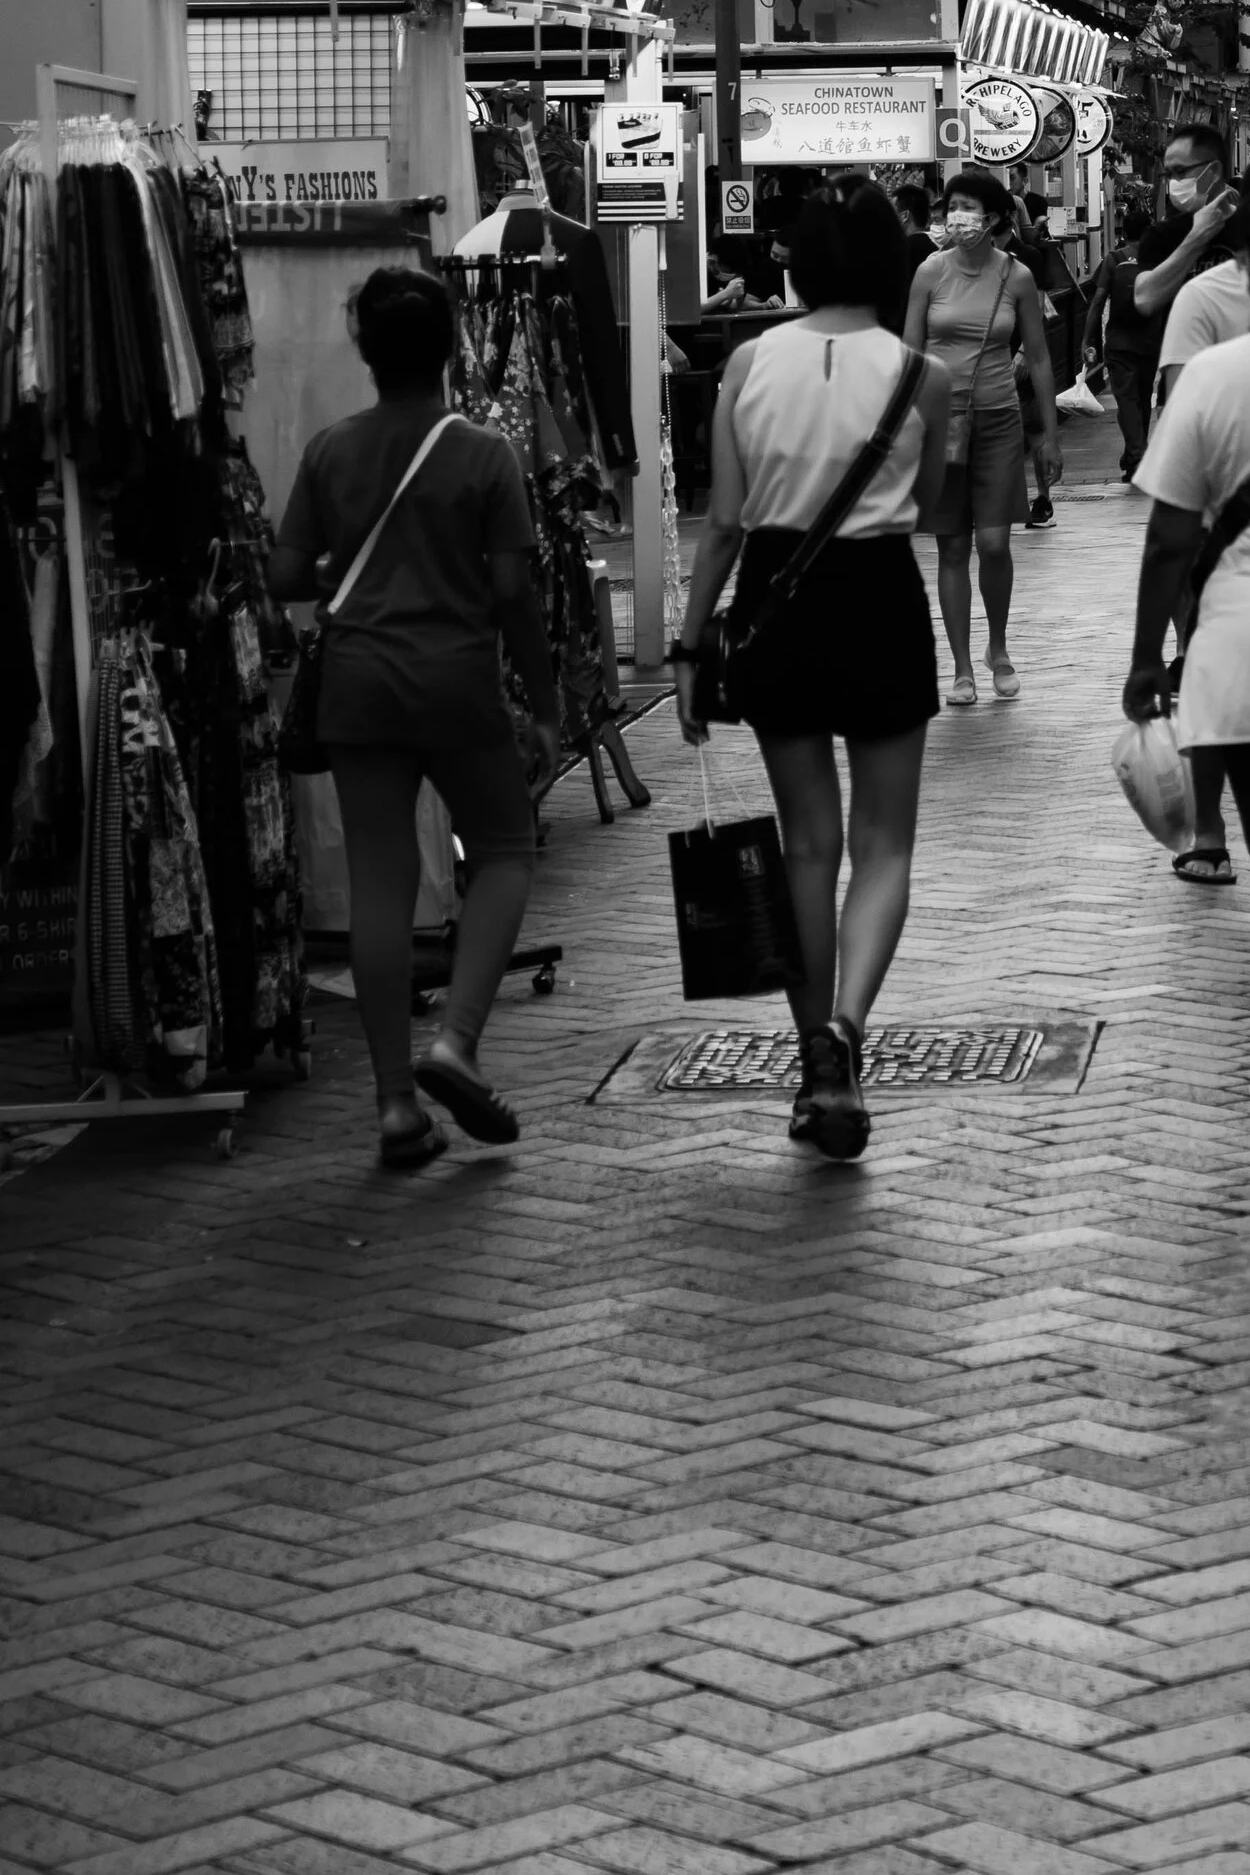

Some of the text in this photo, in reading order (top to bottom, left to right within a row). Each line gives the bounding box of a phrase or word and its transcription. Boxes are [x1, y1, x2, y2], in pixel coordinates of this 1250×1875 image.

[728, 82, 737, 100] 7
[814, 87, 893, 98] CHINATOWN
[781, 100, 926, 115] SEAFOOD RESTAURANT
[939, 118, 969, 151] Q
[284, 171, 378, 201] FASHIONS
